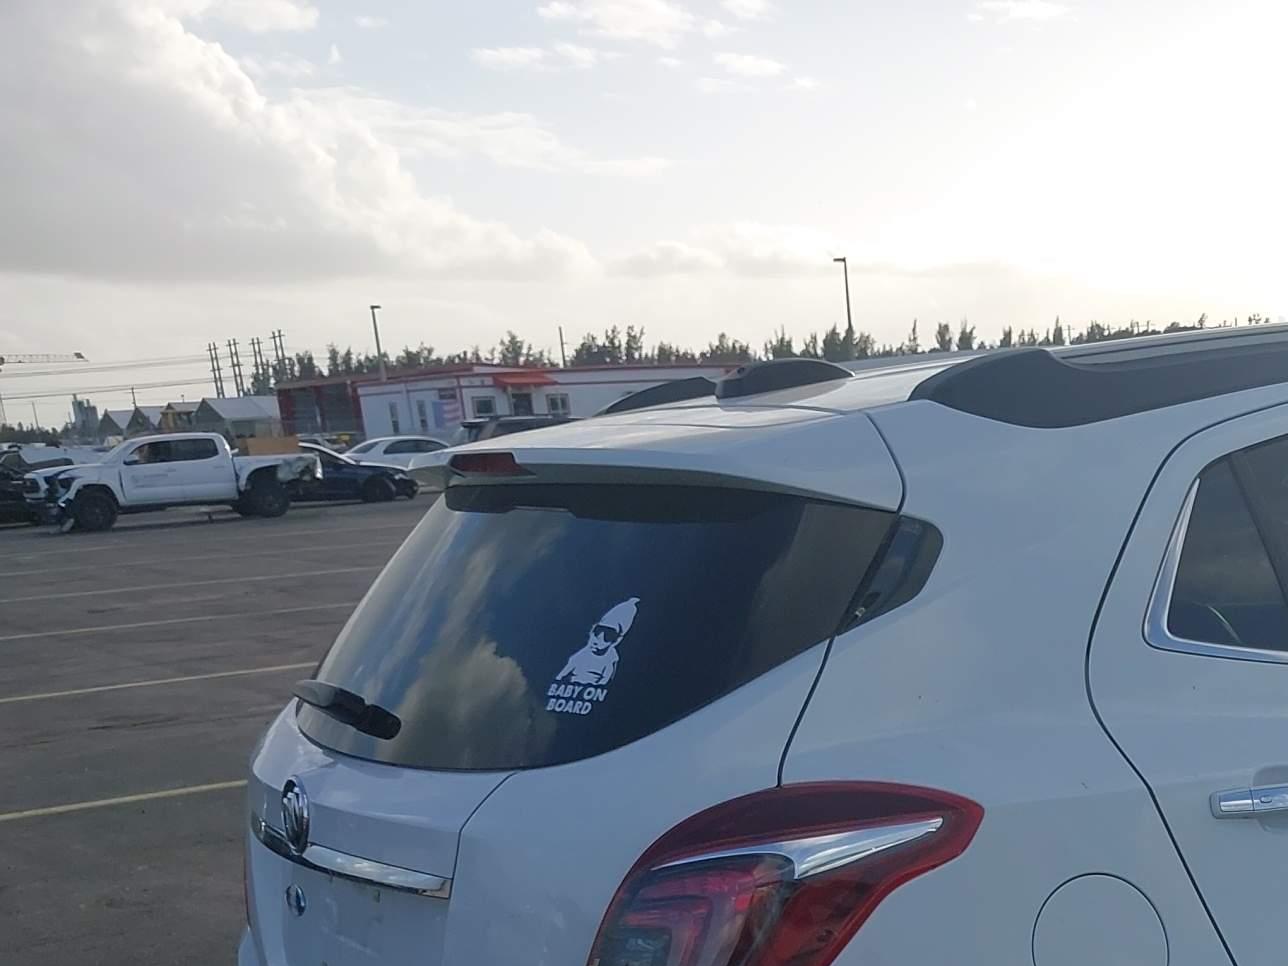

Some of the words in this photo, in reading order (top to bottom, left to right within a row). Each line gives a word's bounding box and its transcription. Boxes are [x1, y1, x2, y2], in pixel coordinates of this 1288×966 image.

[548, 684, 583, 698] BABY
[584, 687, 607, 701] ON
[546, 698, 592, 715] BOARD
